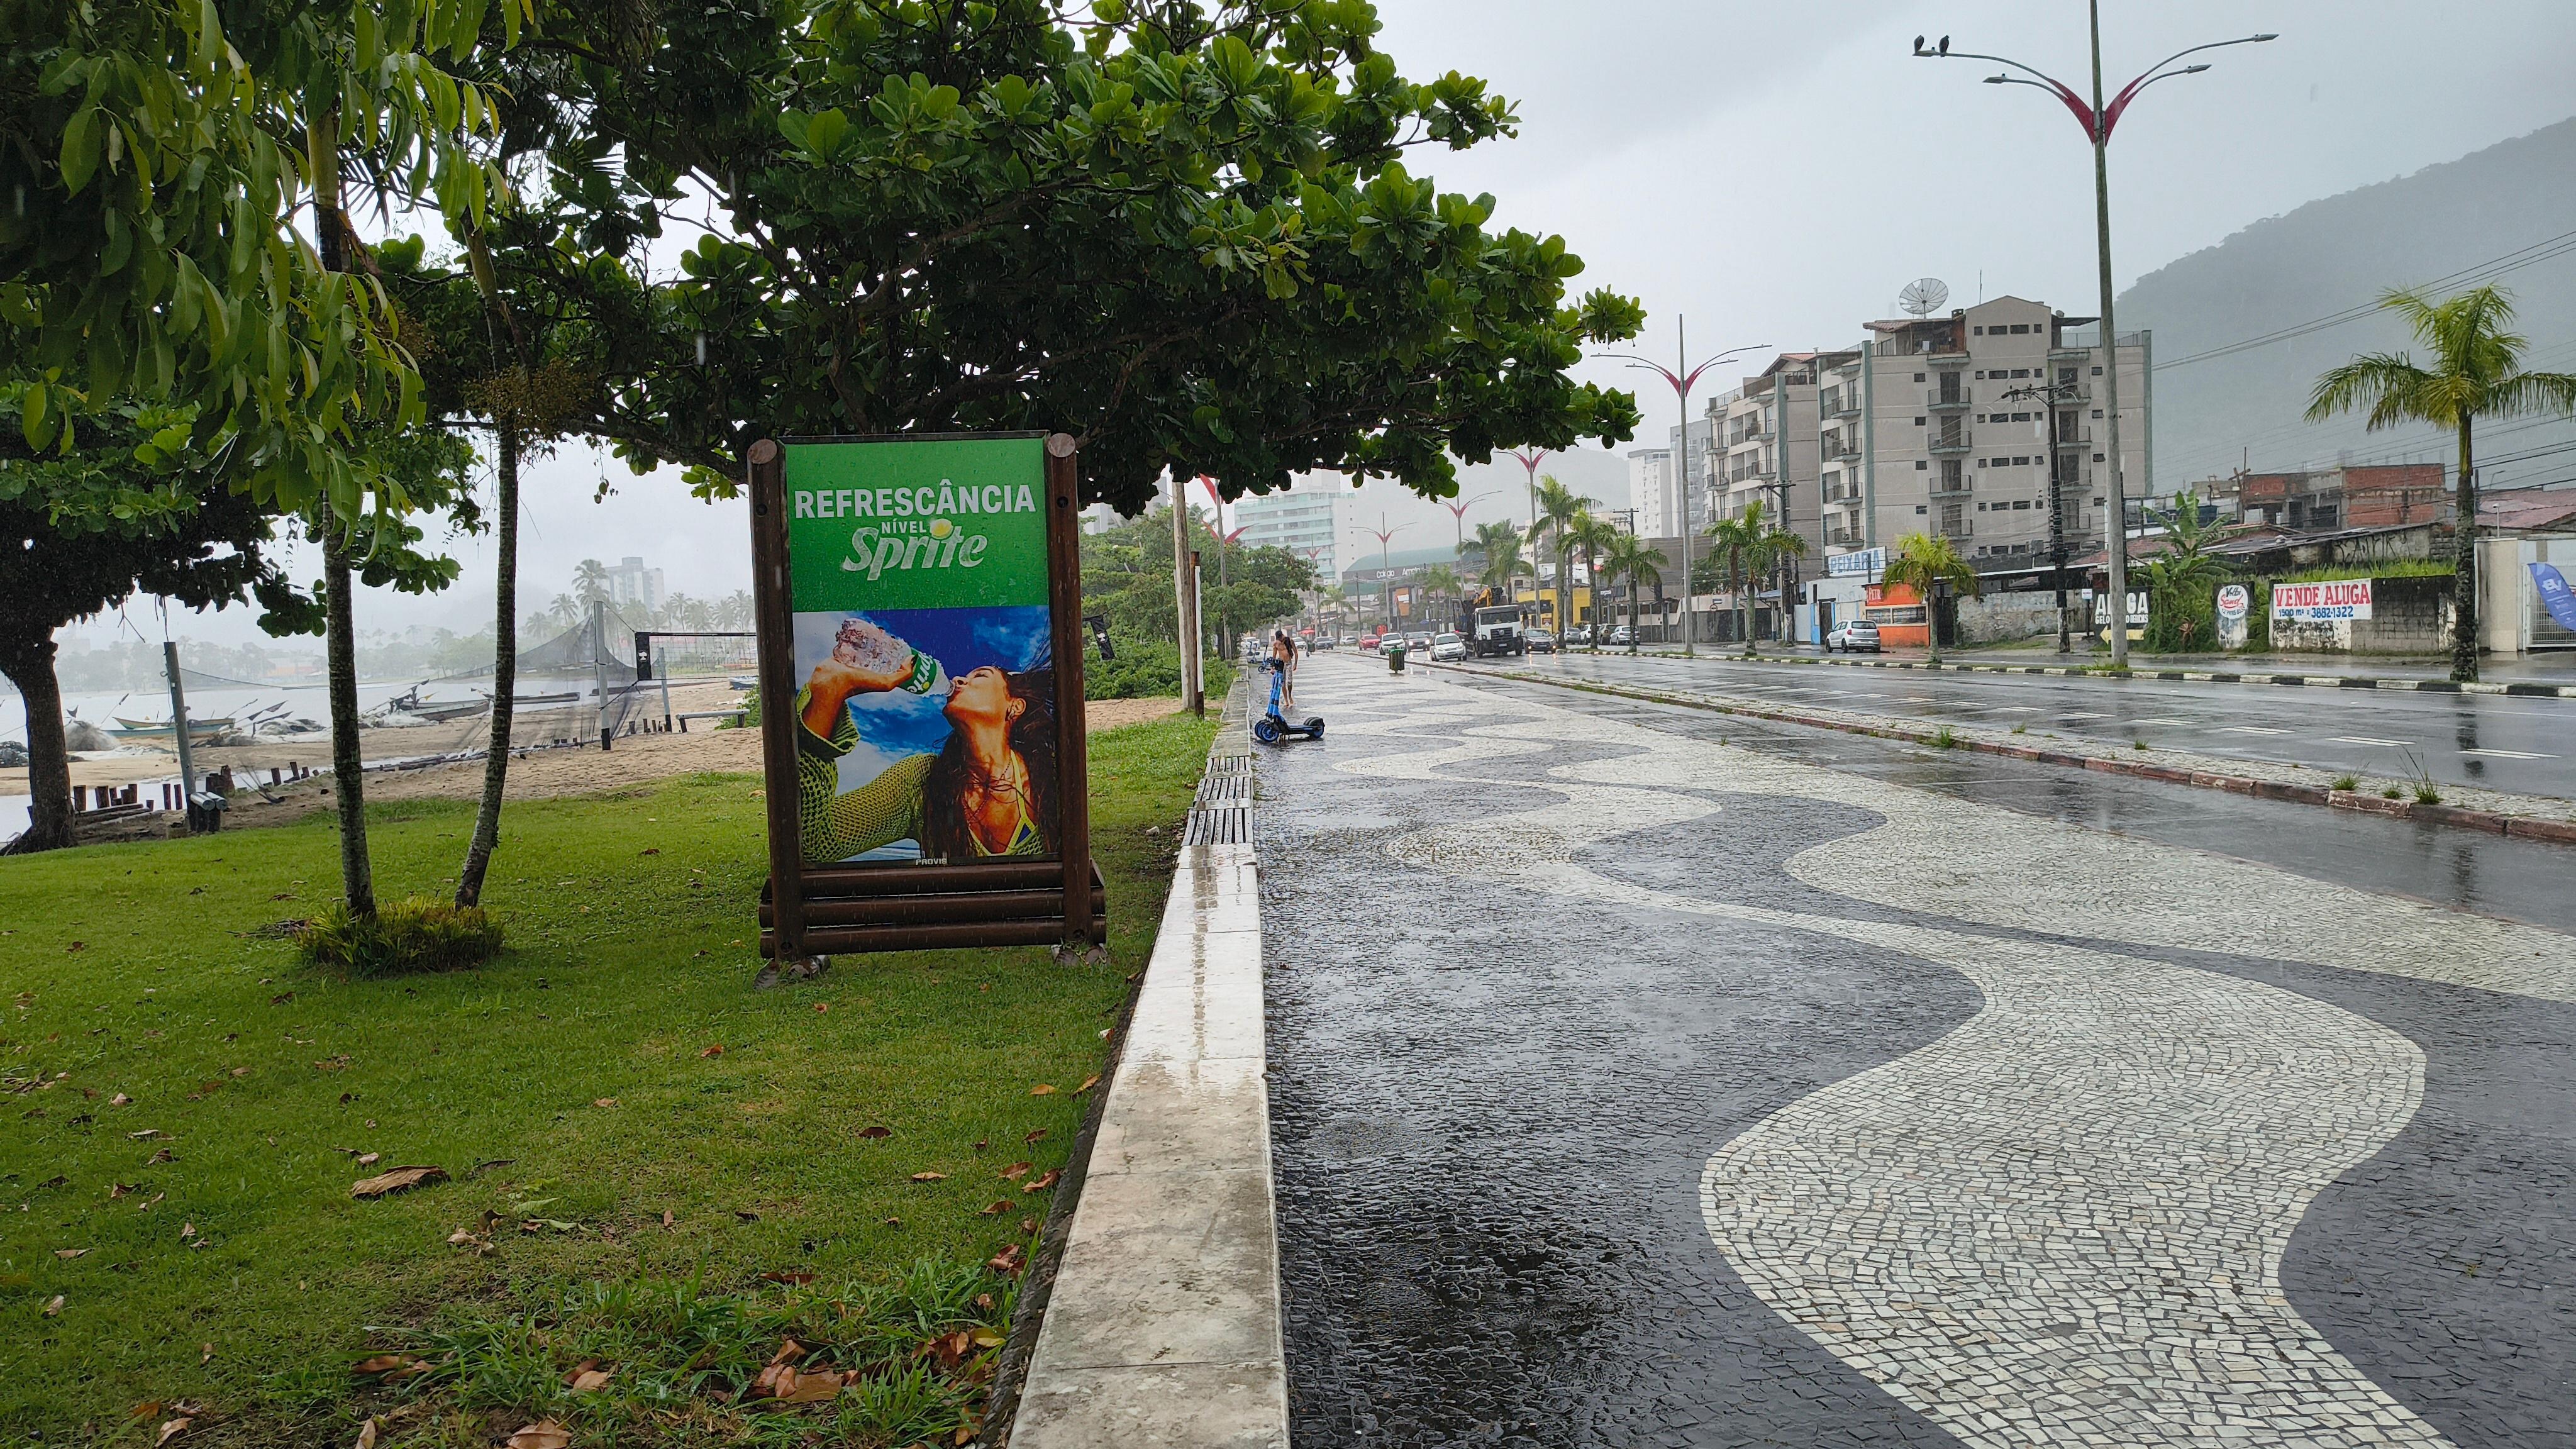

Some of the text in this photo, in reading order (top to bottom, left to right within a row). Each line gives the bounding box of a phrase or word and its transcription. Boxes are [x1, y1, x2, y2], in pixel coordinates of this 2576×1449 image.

[795, 479, 1036, 519] REFRESCÂNCIA
[881, 518, 927, 535] NÍVEL
[843, 521, 988, 581] Sprite
[1830, 550, 1880, 573] PEIXARA
[1377, 570, 1395, 579] Colgio
[2095, 592, 2148, 616] AGA
[2279, 609, 2294, 617] 1500
